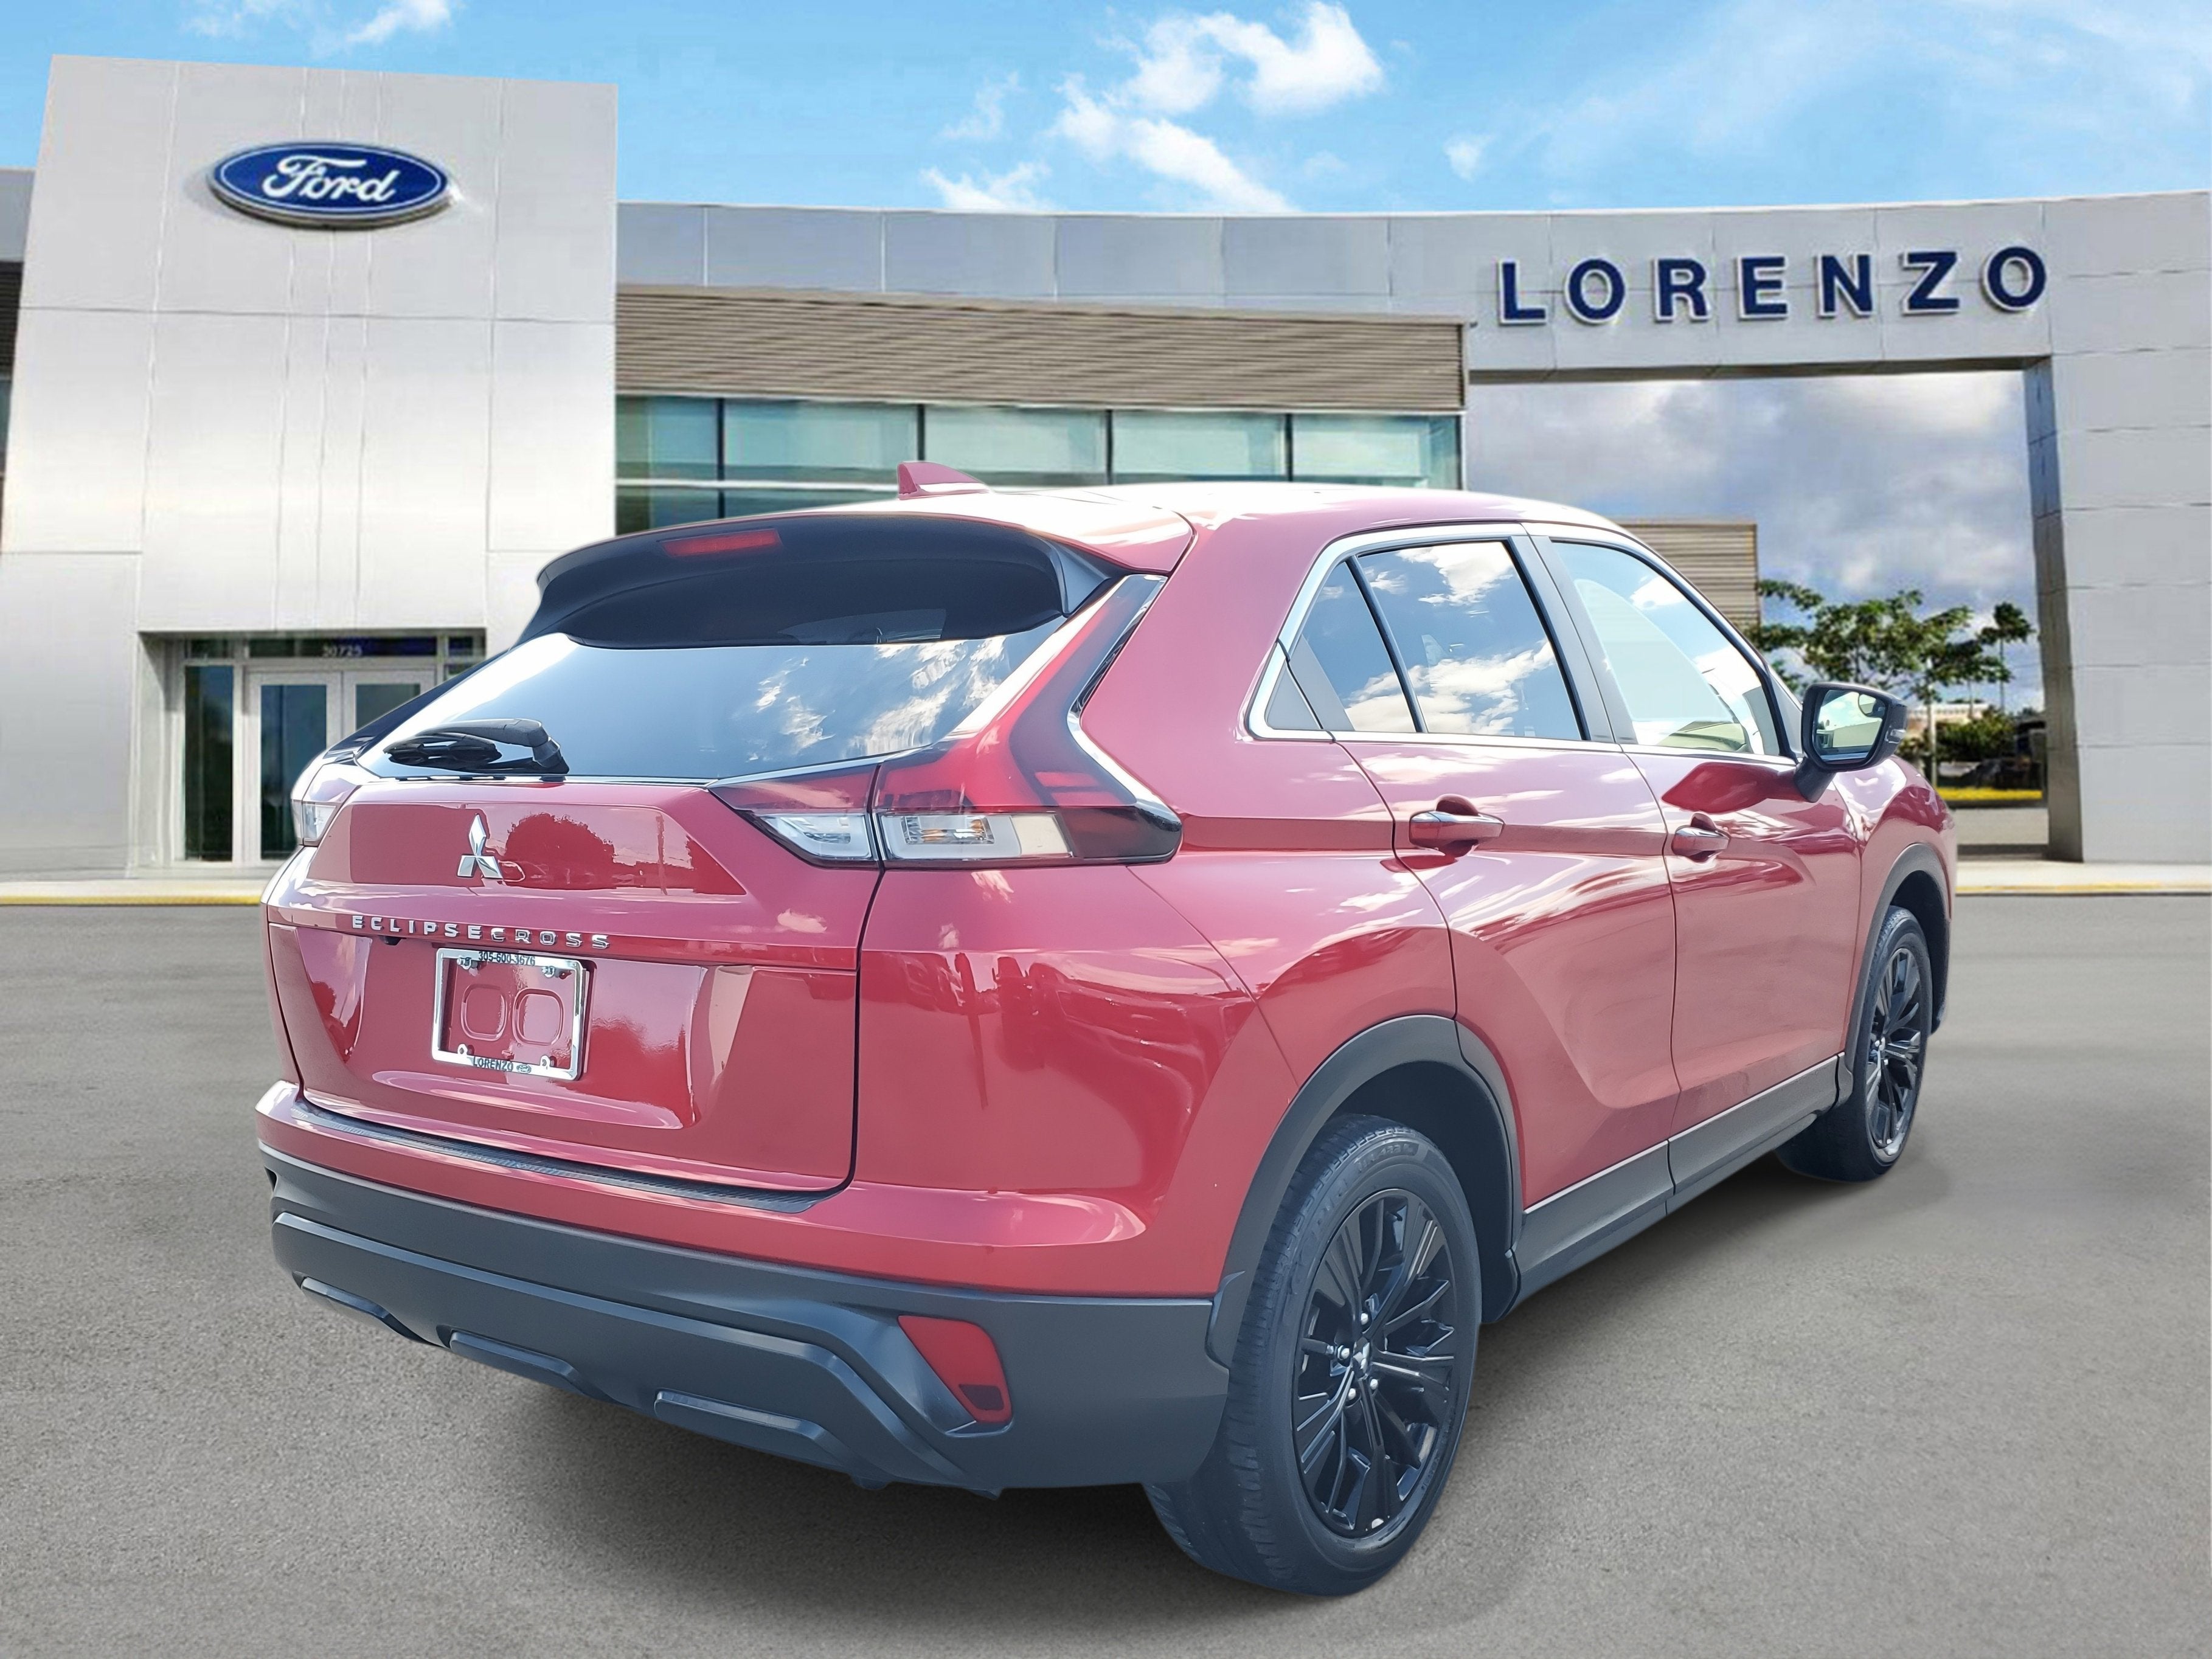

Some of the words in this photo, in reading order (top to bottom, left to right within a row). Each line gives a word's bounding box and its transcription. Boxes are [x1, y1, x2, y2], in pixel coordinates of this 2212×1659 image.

[262, 154, 400, 201] Ford
[1497, 246, 2047, 324] LORENZO
[478, 951, 536, 966] 305-600-3676
[473, 1057, 514, 1072] LORENZO
